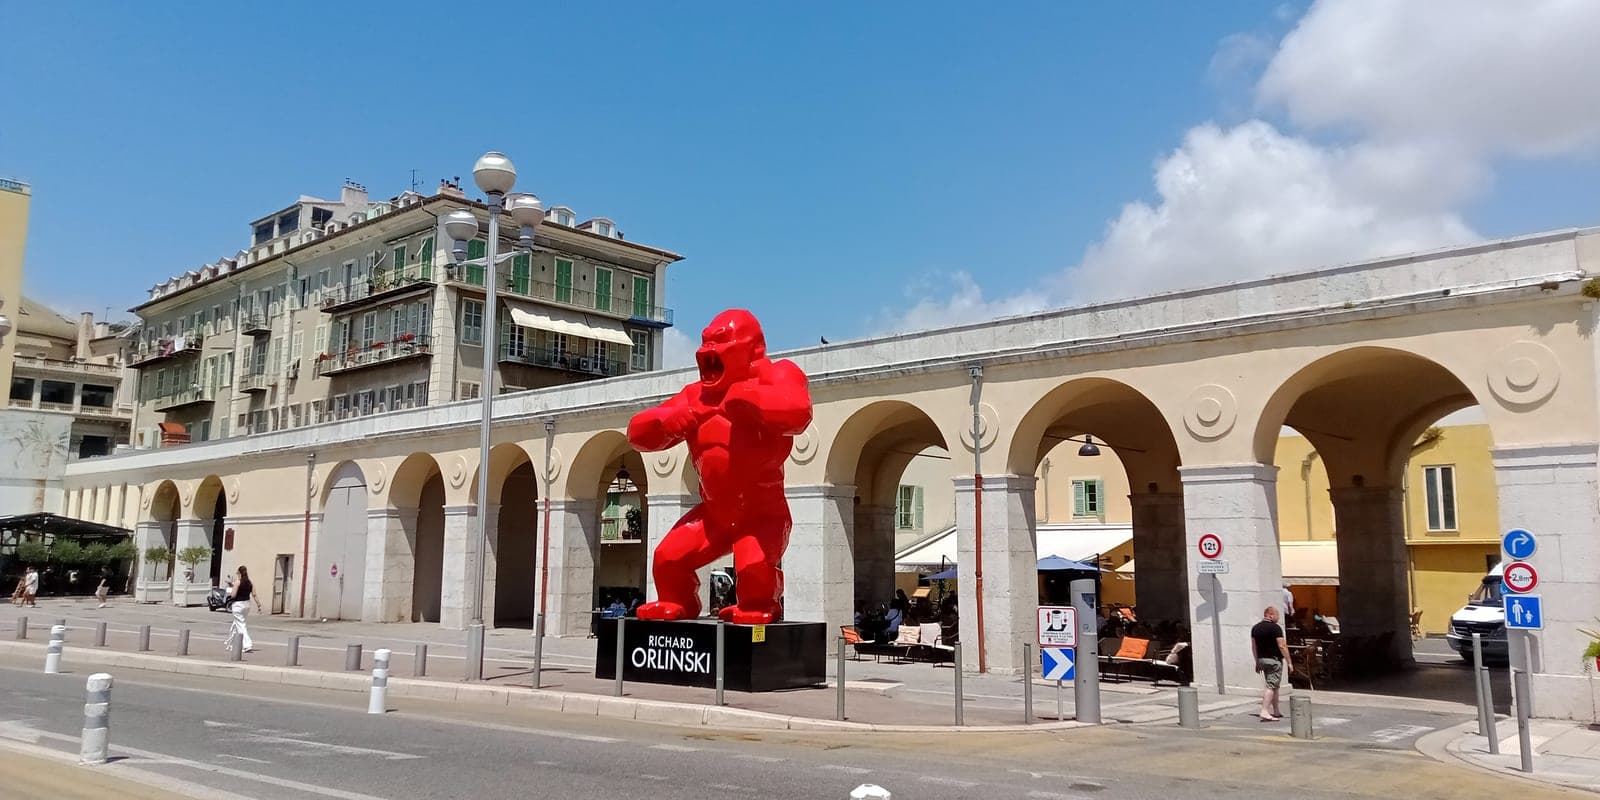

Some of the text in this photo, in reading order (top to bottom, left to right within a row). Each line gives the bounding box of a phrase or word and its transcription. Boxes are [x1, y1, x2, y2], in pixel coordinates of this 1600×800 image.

[1203, 542, 1217, 551] 12t
[648, 635, 694, 649] RICHARD
[631, 647, 711, 674] ORLINSKI
